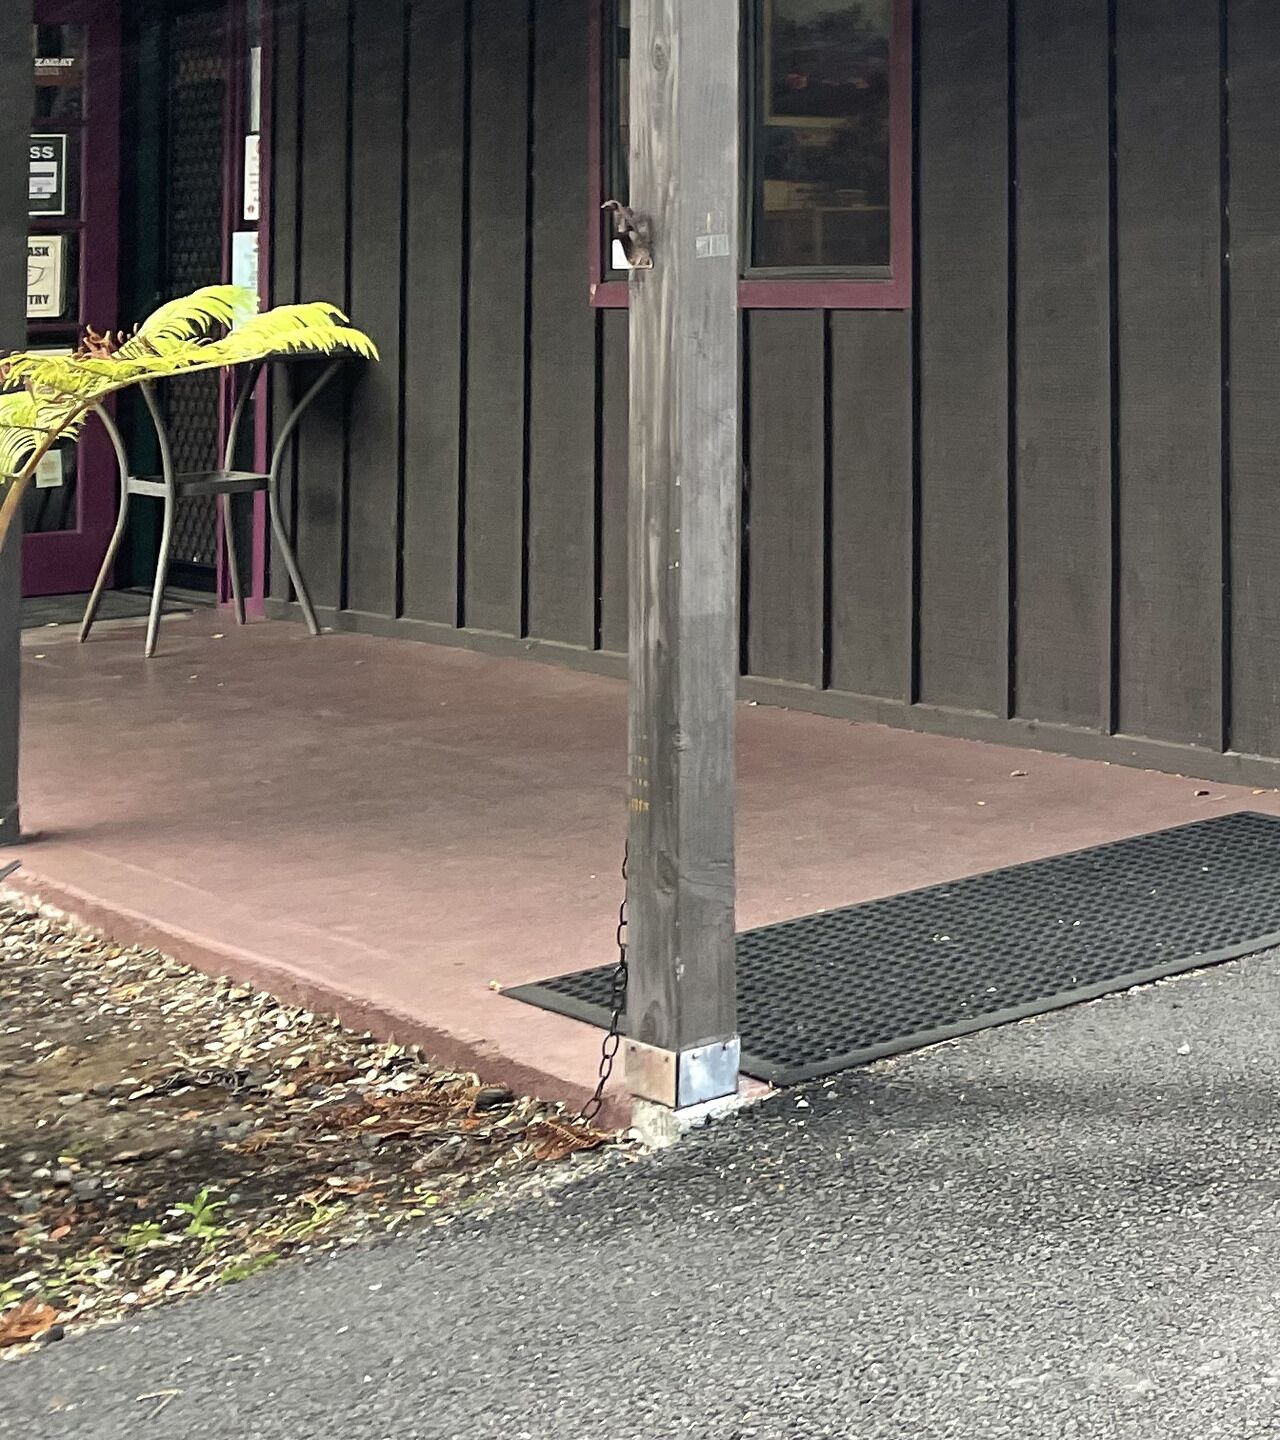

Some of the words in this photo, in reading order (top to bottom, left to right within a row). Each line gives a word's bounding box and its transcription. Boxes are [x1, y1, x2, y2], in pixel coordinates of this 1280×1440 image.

[29, 146, 55, 159] SS
[28, 246, 50, 257] ASK
[27, 294, 50, 305] TRY
